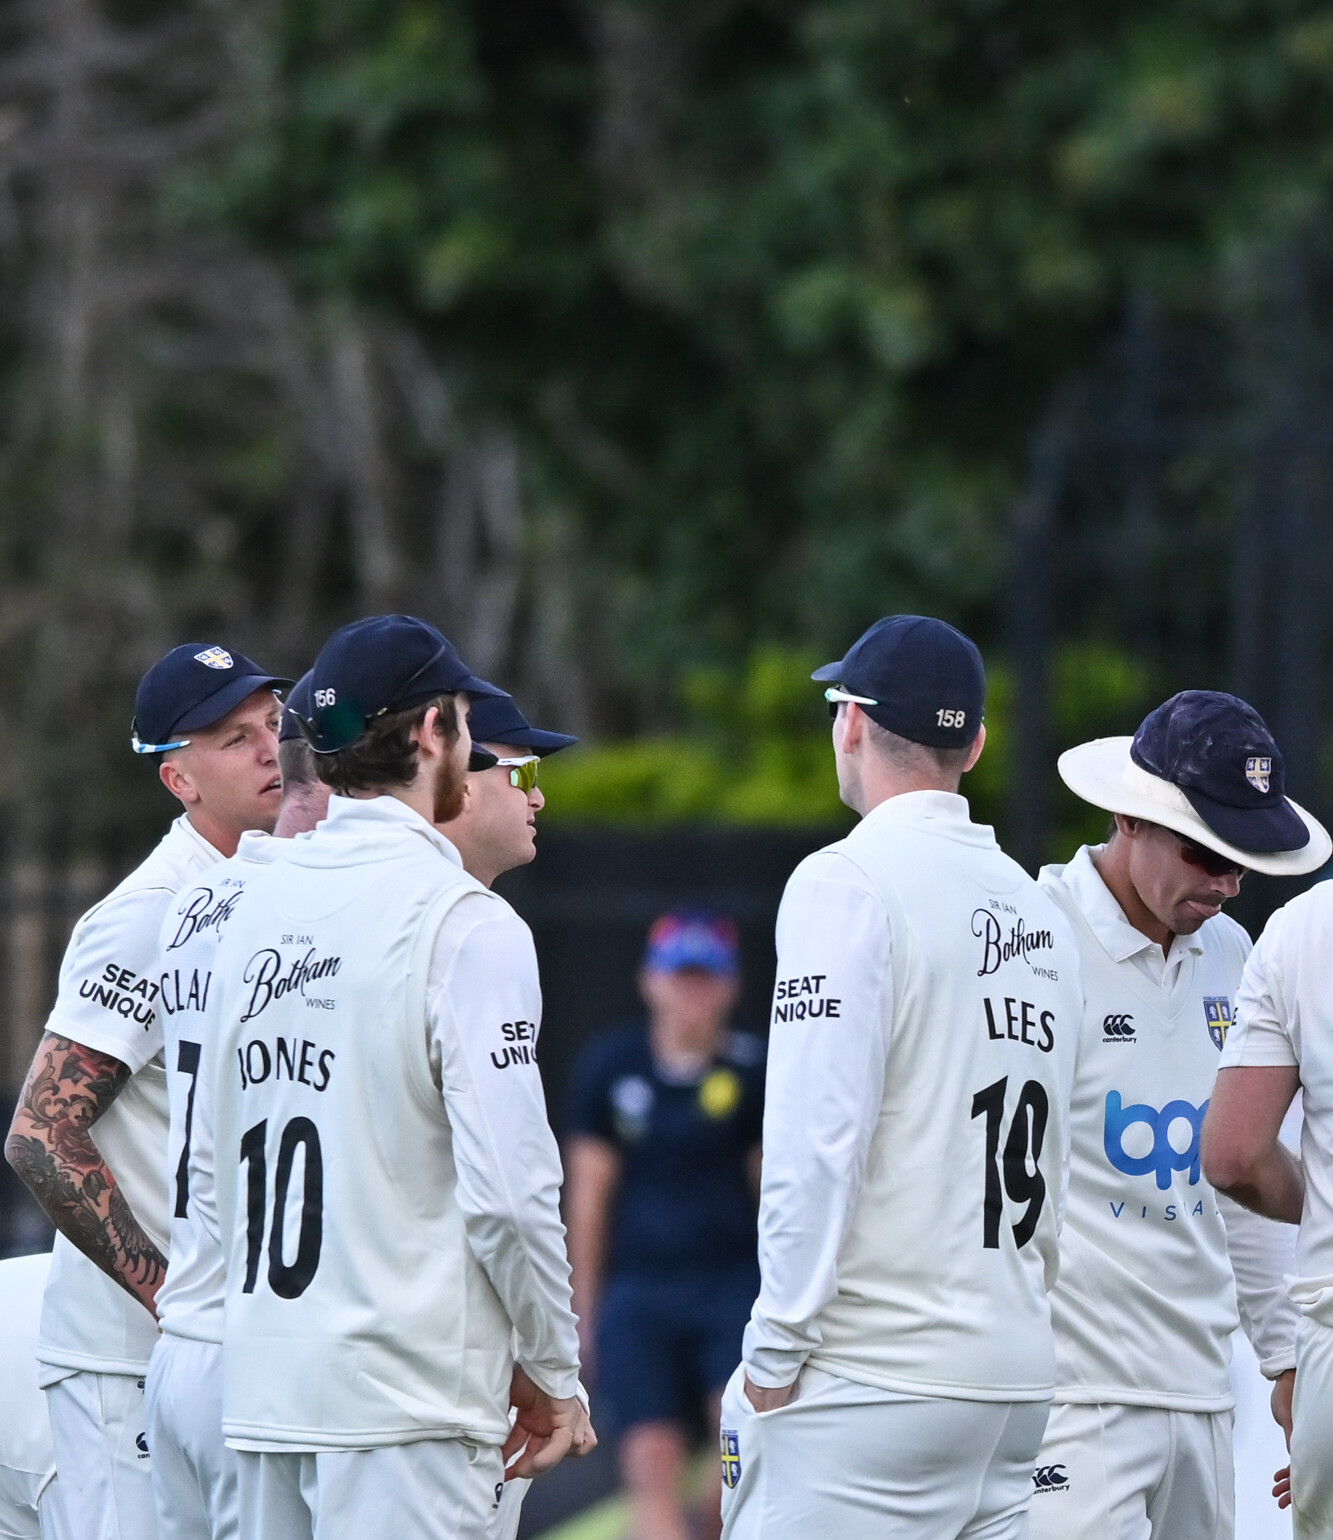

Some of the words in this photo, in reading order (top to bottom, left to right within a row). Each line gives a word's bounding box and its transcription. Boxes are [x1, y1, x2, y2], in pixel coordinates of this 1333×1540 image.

[314, 688, 336, 708] 156
[935, 708, 966, 728] 158
[988, 899, 1002, 910] SIR
[1002, 903, 1017, 916] IAN
[280, 934, 295, 945] SIR
[297, 935, 314, 946] IAN
[971, 908, 1054, 977] Botham
[243, 947, 342, 1023] Botham
[1031, 965, 1059, 982] WINES
[776, 974, 827, 1001] SEAT
[305, 999, 336, 1010] WINES
[774, 998, 842, 1025] NIQUE
[983, 997, 1055, 1053] LEES
[1102, 1035, 1137, 1044] canterbury
[237, 1036, 337, 1092] JONES
[175, 1040, 202, 1219] 7
[971, 1074, 1050, 1250] 19
[240, 1115, 324, 1300] 10
